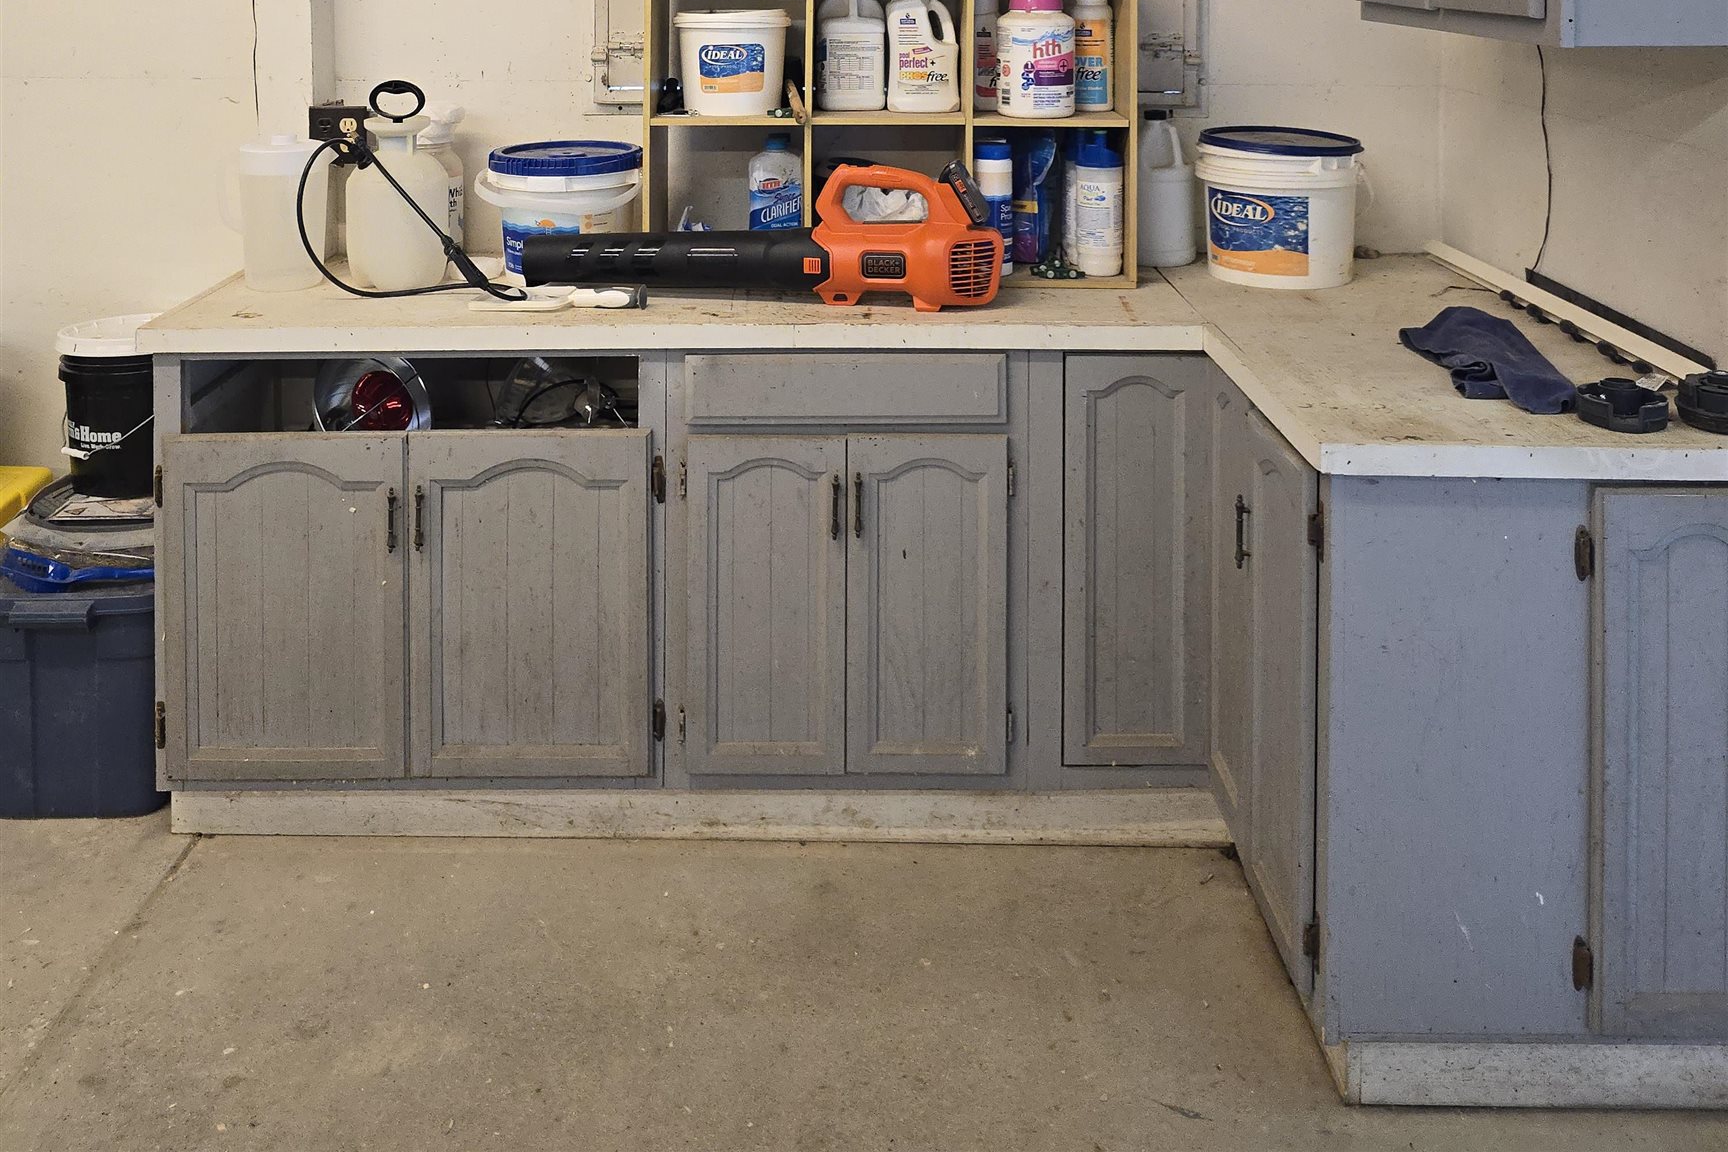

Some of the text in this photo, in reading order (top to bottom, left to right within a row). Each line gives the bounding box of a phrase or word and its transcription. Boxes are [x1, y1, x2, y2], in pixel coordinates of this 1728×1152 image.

[707, 46, 743, 60] IDEAL
[1033, 38, 1062, 59] hth
[899, 56, 928, 70] perfect
[1076, 66, 1102, 80] free
[1215, 193, 1267, 221] IDEAL
[867, 266, 901, 274] DECKER
